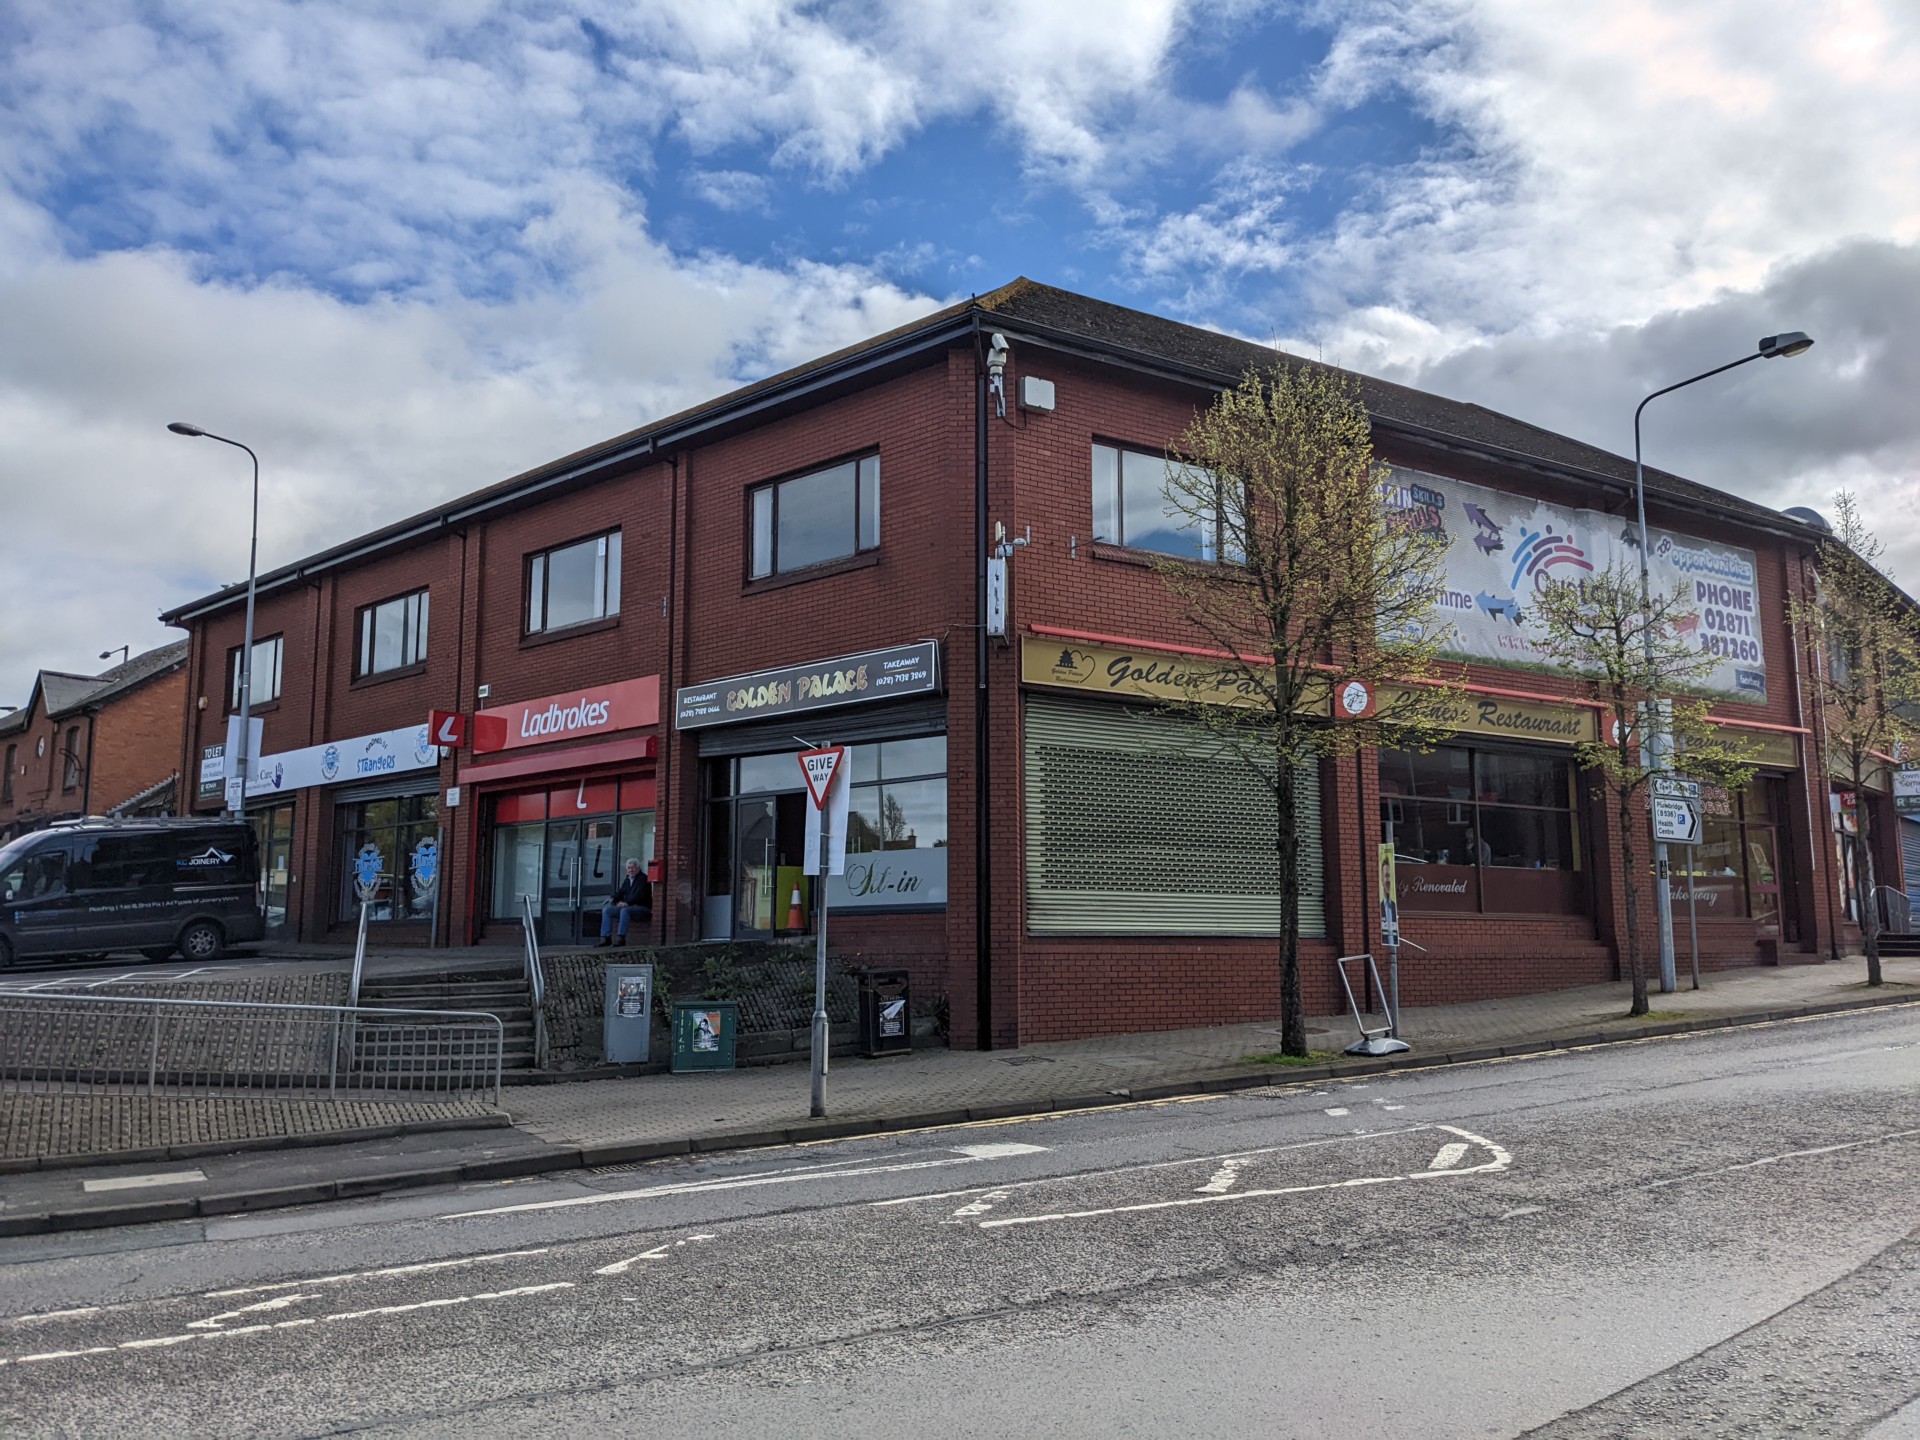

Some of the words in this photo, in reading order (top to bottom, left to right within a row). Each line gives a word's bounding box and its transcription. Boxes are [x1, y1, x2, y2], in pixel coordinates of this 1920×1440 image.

[1412, 486, 1444, 508] SKILLS
[1672, 548, 1752, 579] opportunities
[1696, 580, 1753, 612] PHONE
[1705, 607, 1751, 637] 02871
[1700, 633, 1759, 663] 382260
[883, 657, 920, 669] TAKEAWAY
[1106, 655, 1204, 689] Golden
[683, 692, 718, 704] RESTAURANT
[726, 680, 792, 712] GOLDEN
[797, 664, 868, 700] PALACE
[521, 698, 610, 738] Ladbrokes
[1477, 700, 1582, 736] Restaurant
[204, 748, 212, 758] TO
[212, 746, 223, 757] LET
[807, 756, 833, 771] GIVE
[812, 772, 829, 782] WAY
[1658, 820, 1673, 828] Health
[1658, 828, 1674, 836] Centre
[188, 858, 220, 866] JOINERY
[845, 858, 923, 897] Sit-in
[1412, 876, 1468, 893] Renovated
